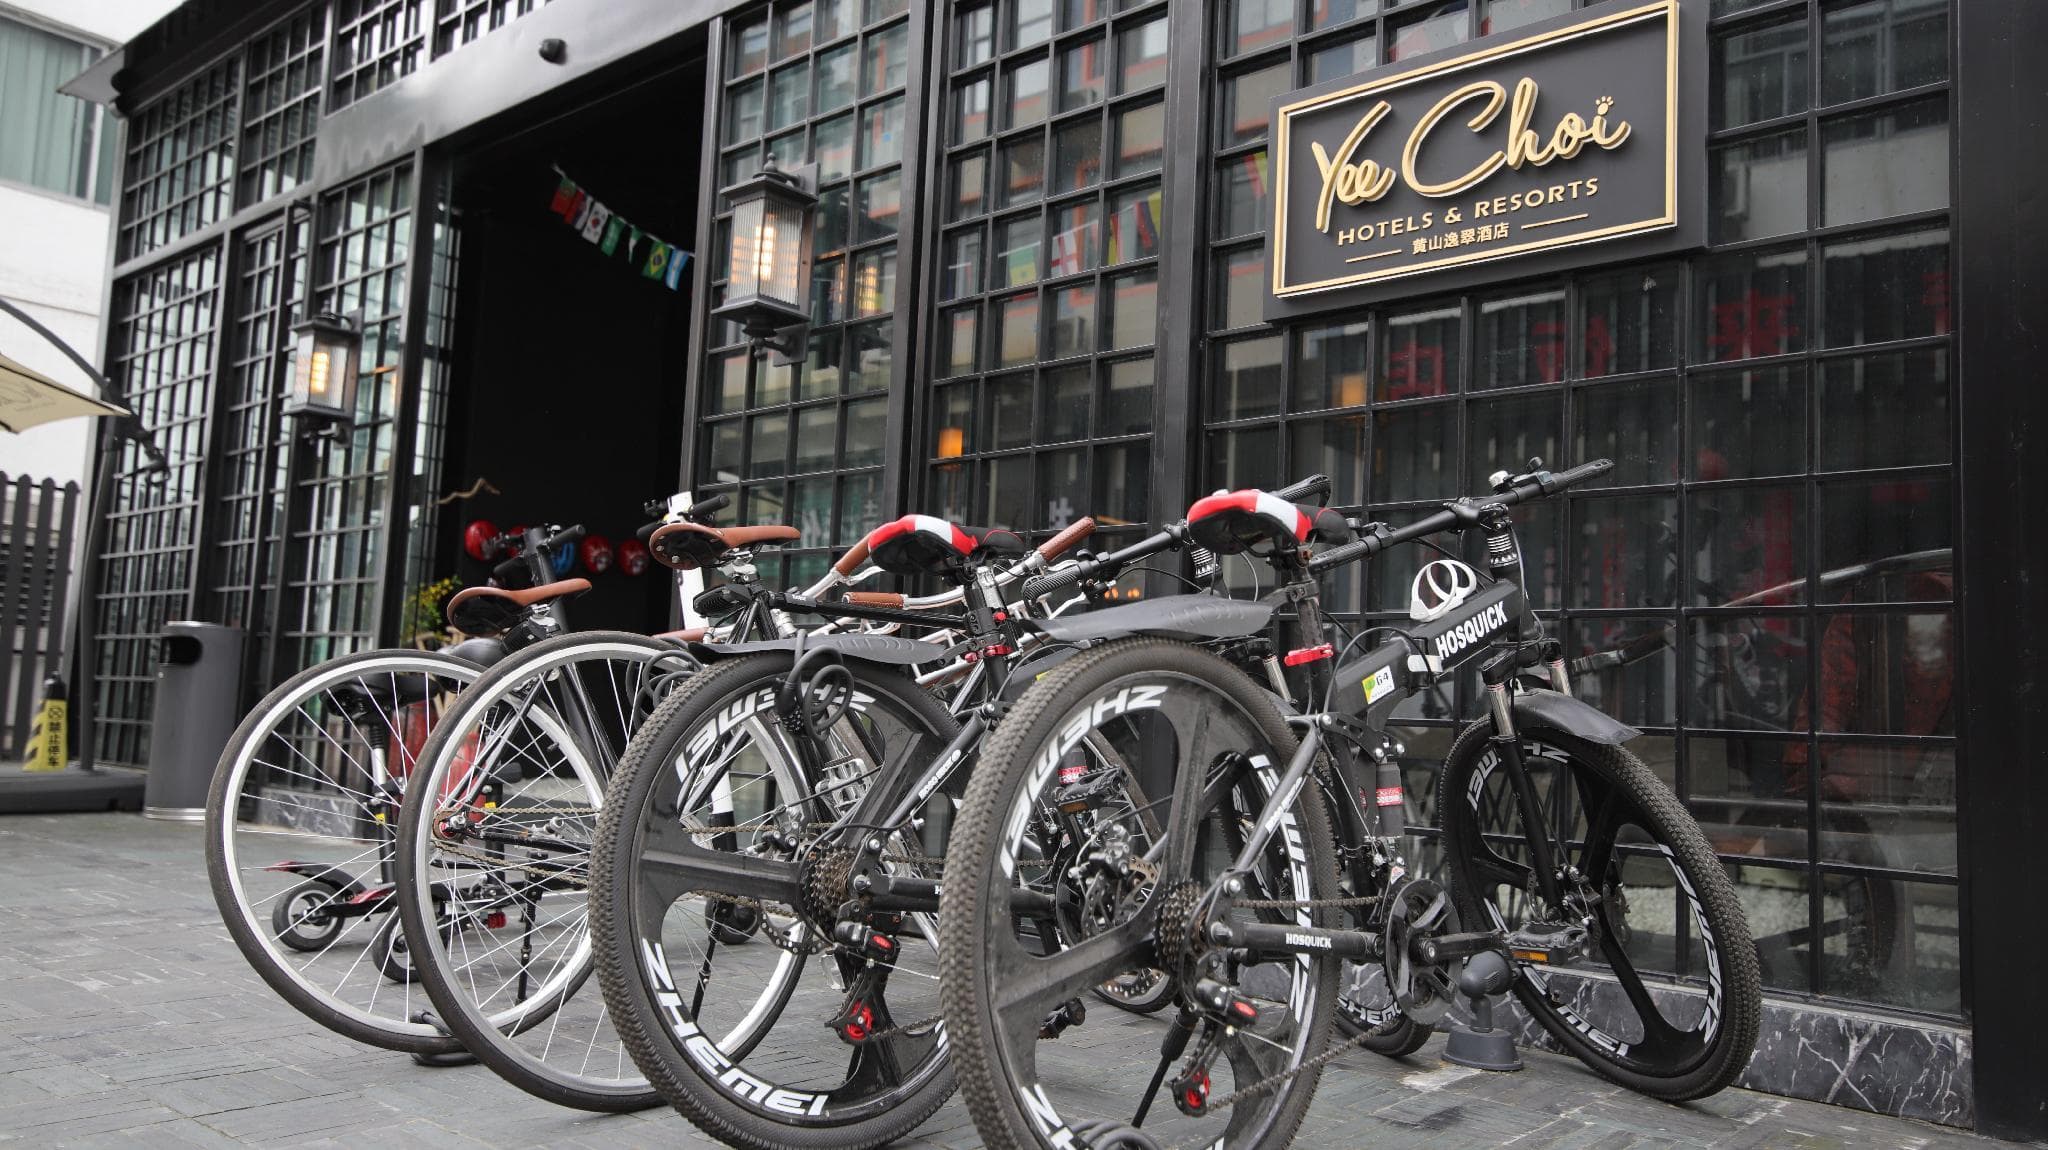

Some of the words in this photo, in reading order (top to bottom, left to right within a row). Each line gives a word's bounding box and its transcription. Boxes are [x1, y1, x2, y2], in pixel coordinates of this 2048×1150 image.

[1311, 100, 1396, 233] Yee
[1401, 77, 1631, 198] Choi
[1337, 212, 1433, 246] HOTELS
[1444, 207, 1463, 224] &
[1474, 178, 1600, 219] RESORTS
[1435, 600, 1508, 660] HOSQUICK
[1285, 932, 1332, 950] HOSQUICK
